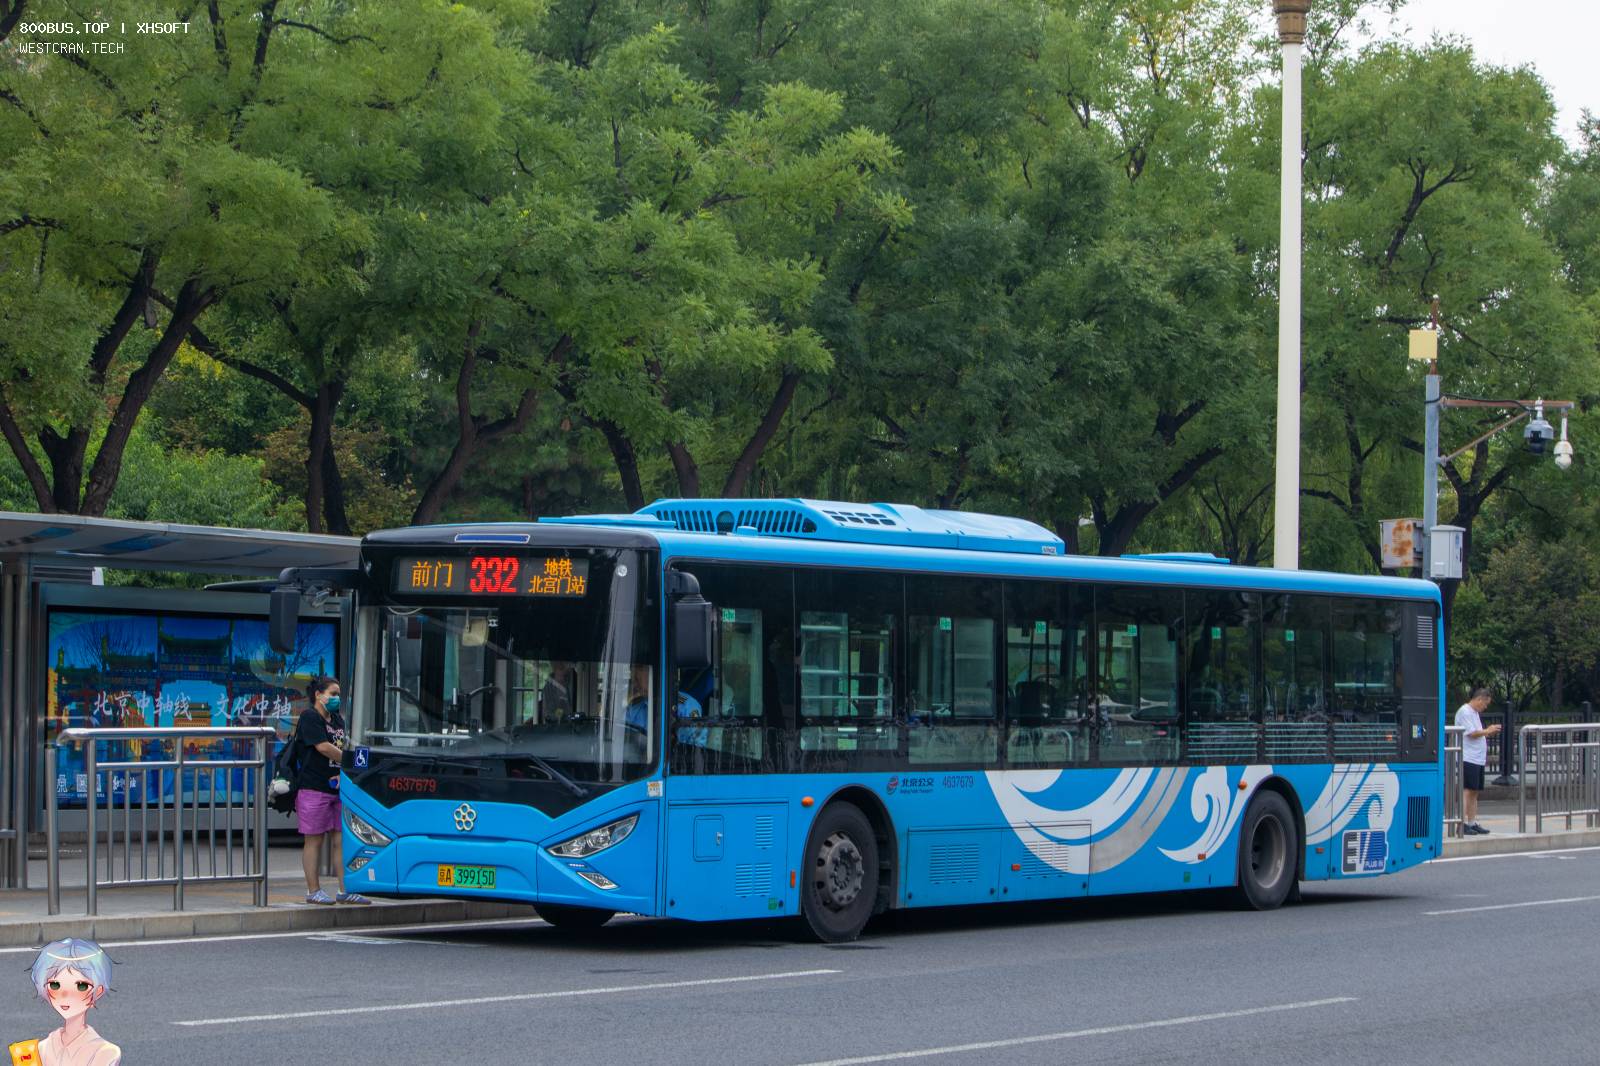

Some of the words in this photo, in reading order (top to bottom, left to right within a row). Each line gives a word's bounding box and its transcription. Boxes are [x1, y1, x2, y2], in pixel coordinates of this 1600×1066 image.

[411, 561, 453, 588] 前门
[470, 557, 519, 593] 332
[544, 558, 573, 577] 地铁
[528, 575, 586, 595] 北宫门站
[389, 777, 437, 793] 4637679
